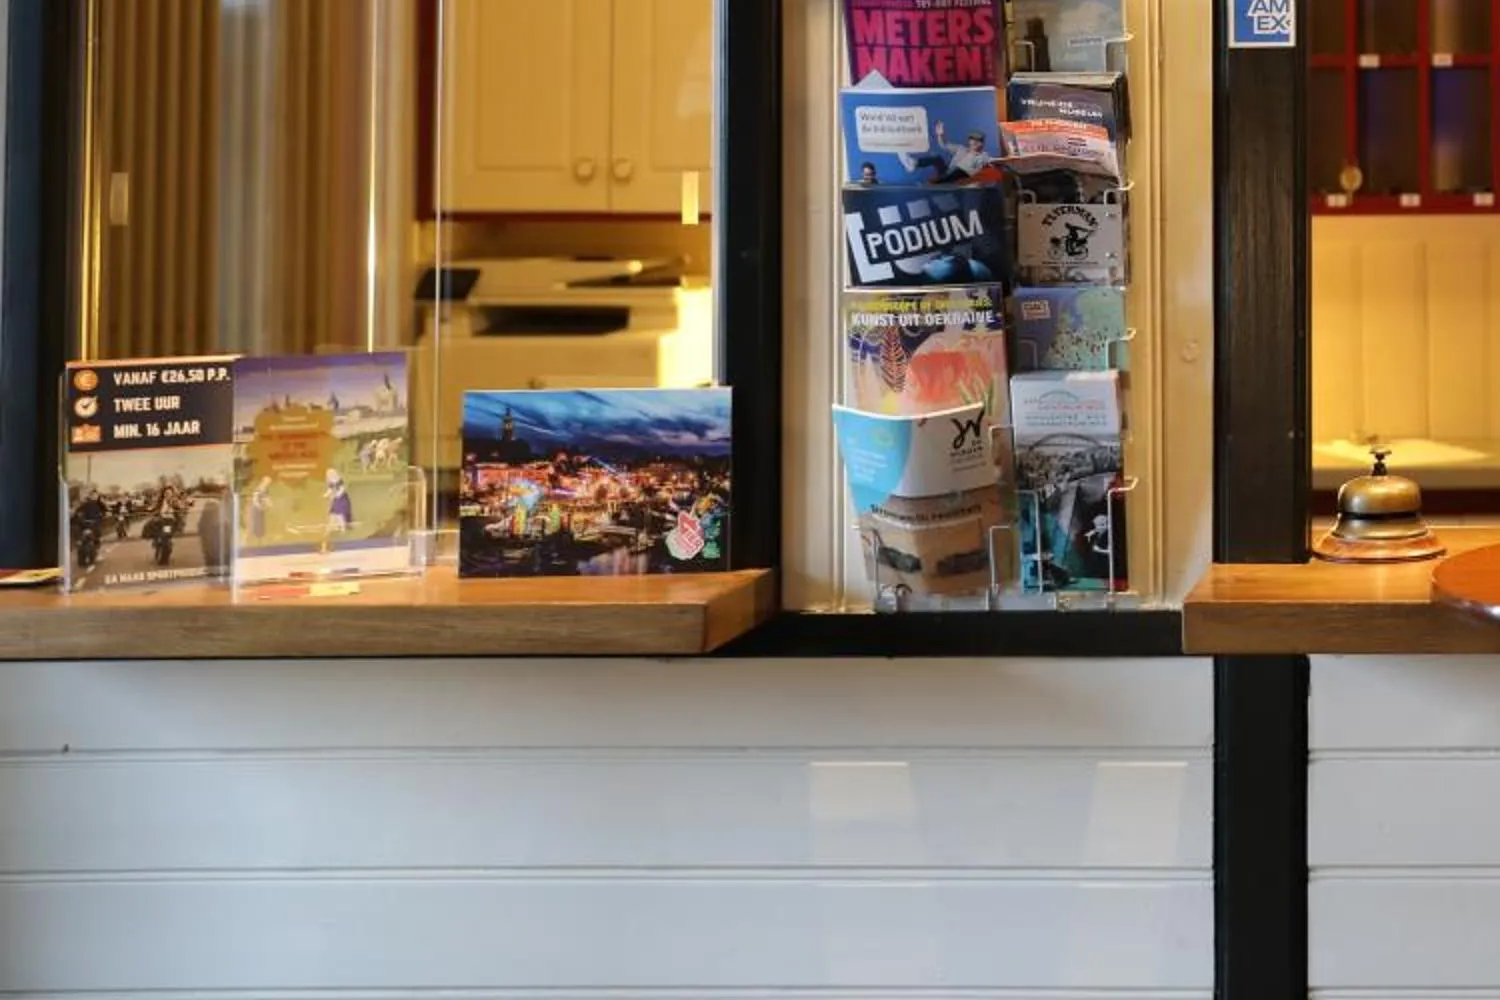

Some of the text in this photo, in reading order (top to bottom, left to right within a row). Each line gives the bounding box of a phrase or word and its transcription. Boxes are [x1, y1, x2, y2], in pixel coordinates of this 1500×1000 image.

[853, 8, 994, 45] METERS
[1256, 14, 1289, 32] EX
[865, 208, 985, 260] PODIUM
[113, 370, 157, 386] VANAF
[207, 367, 231, 382] P.P.
[113, 395, 180, 412] TWEE UUR
[113, 420, 200, 439] MIN. 16 JAAR
